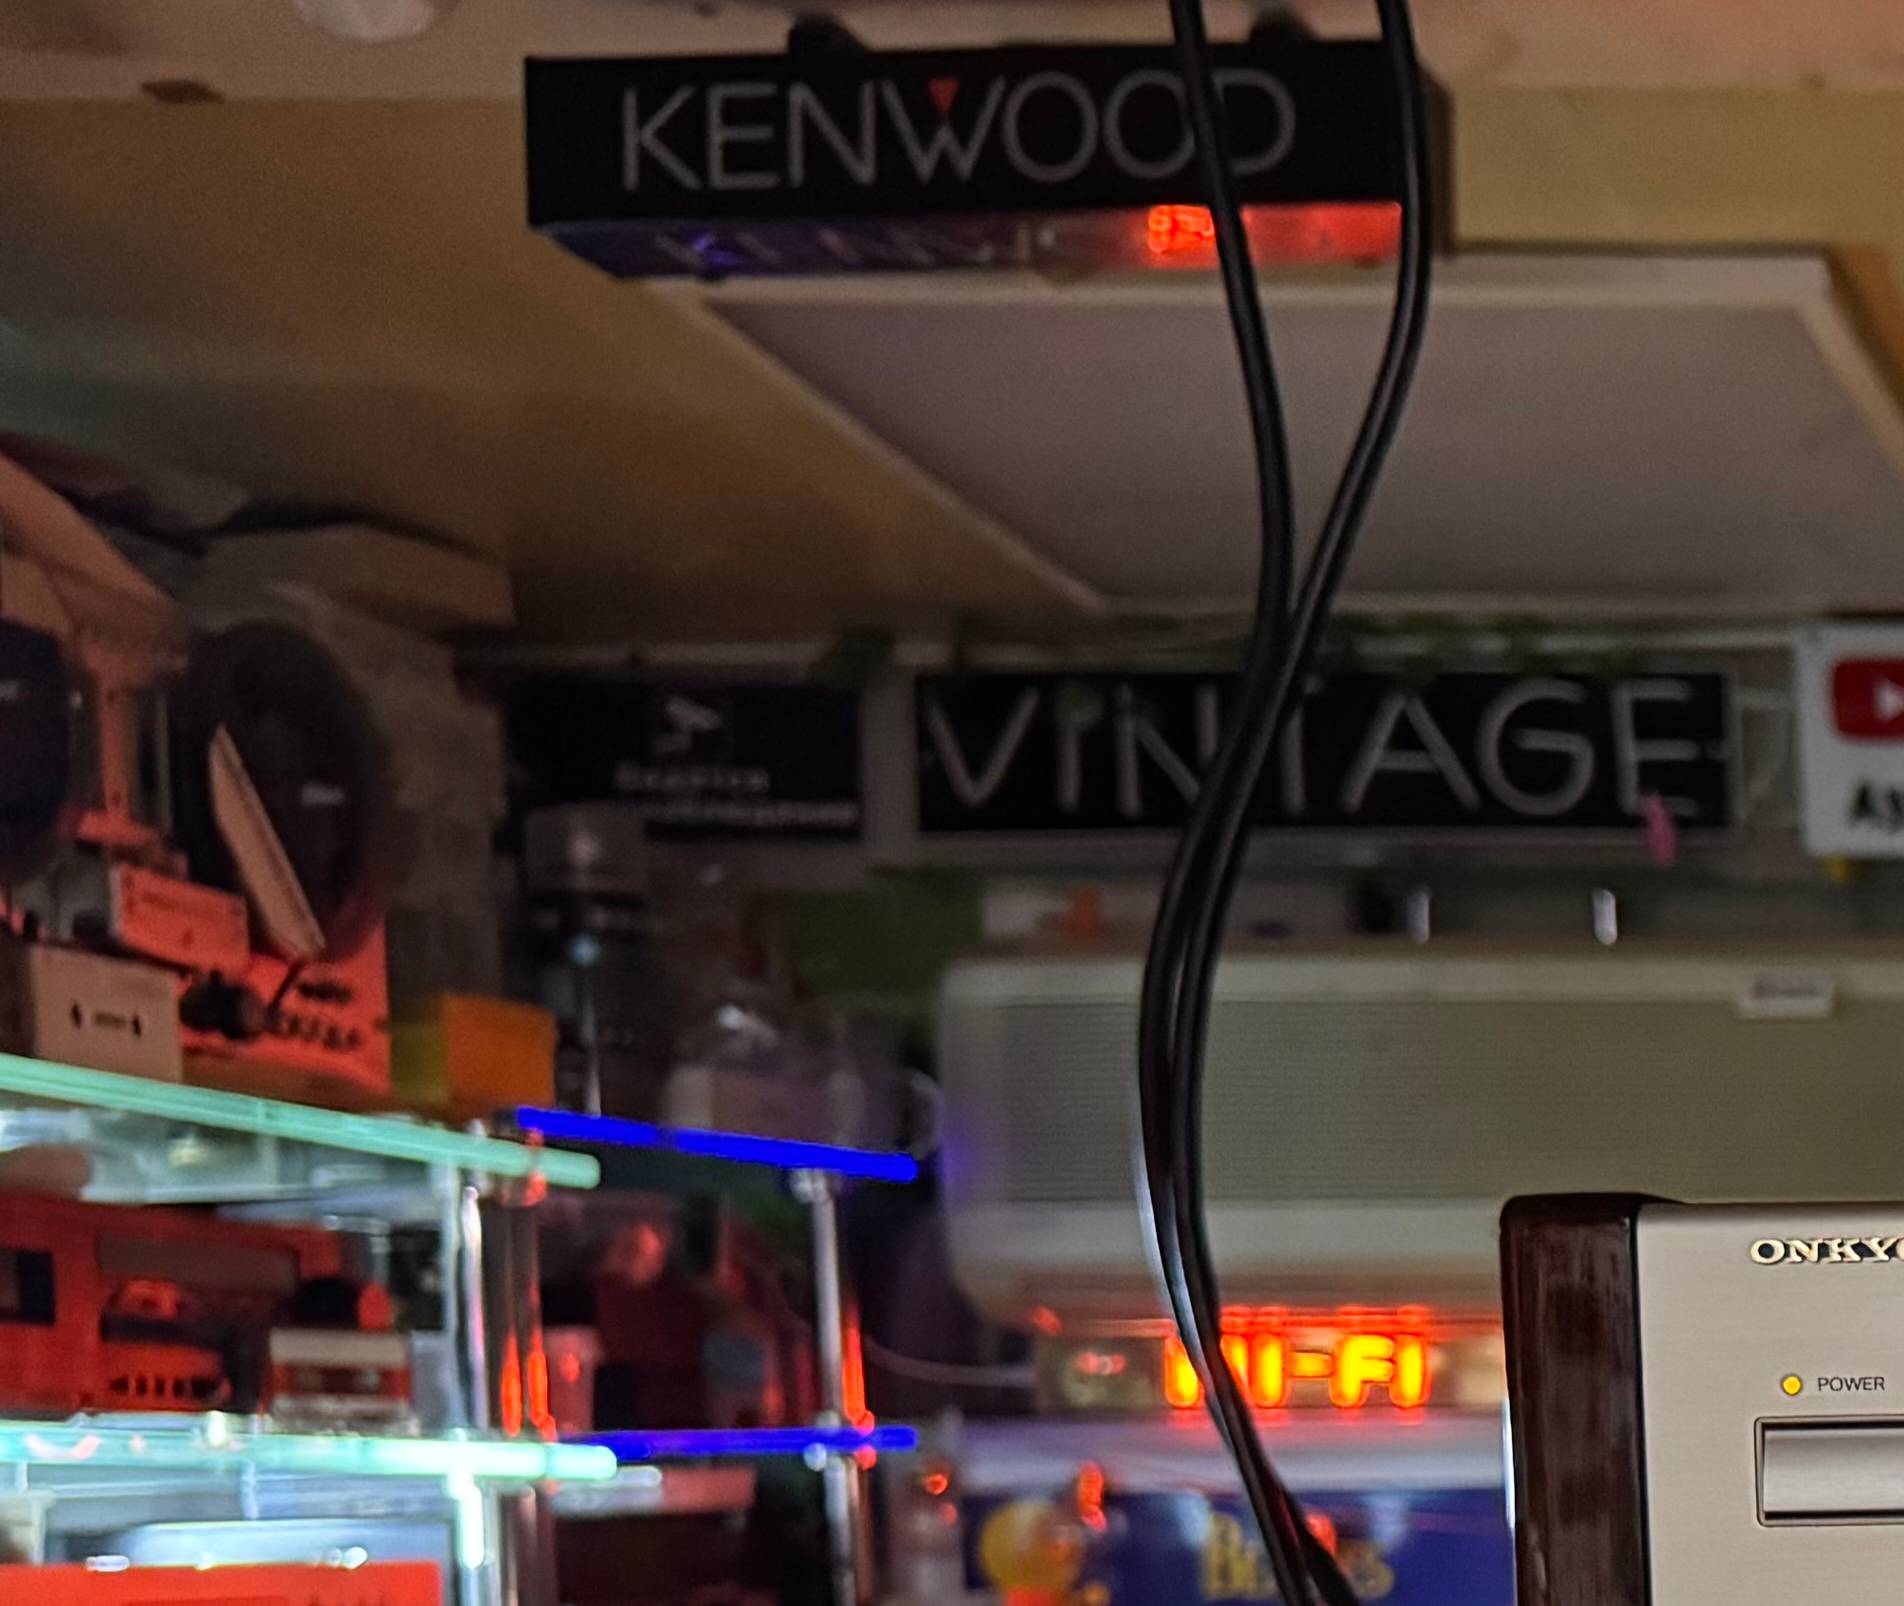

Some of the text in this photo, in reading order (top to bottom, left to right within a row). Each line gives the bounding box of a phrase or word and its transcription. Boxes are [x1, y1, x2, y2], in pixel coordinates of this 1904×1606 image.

[622, 69, 1297, 191] KENWOOD
[926, 677, 1700, 817] VINTAGE
[1817, 1376, 1885, 1392] POWER
